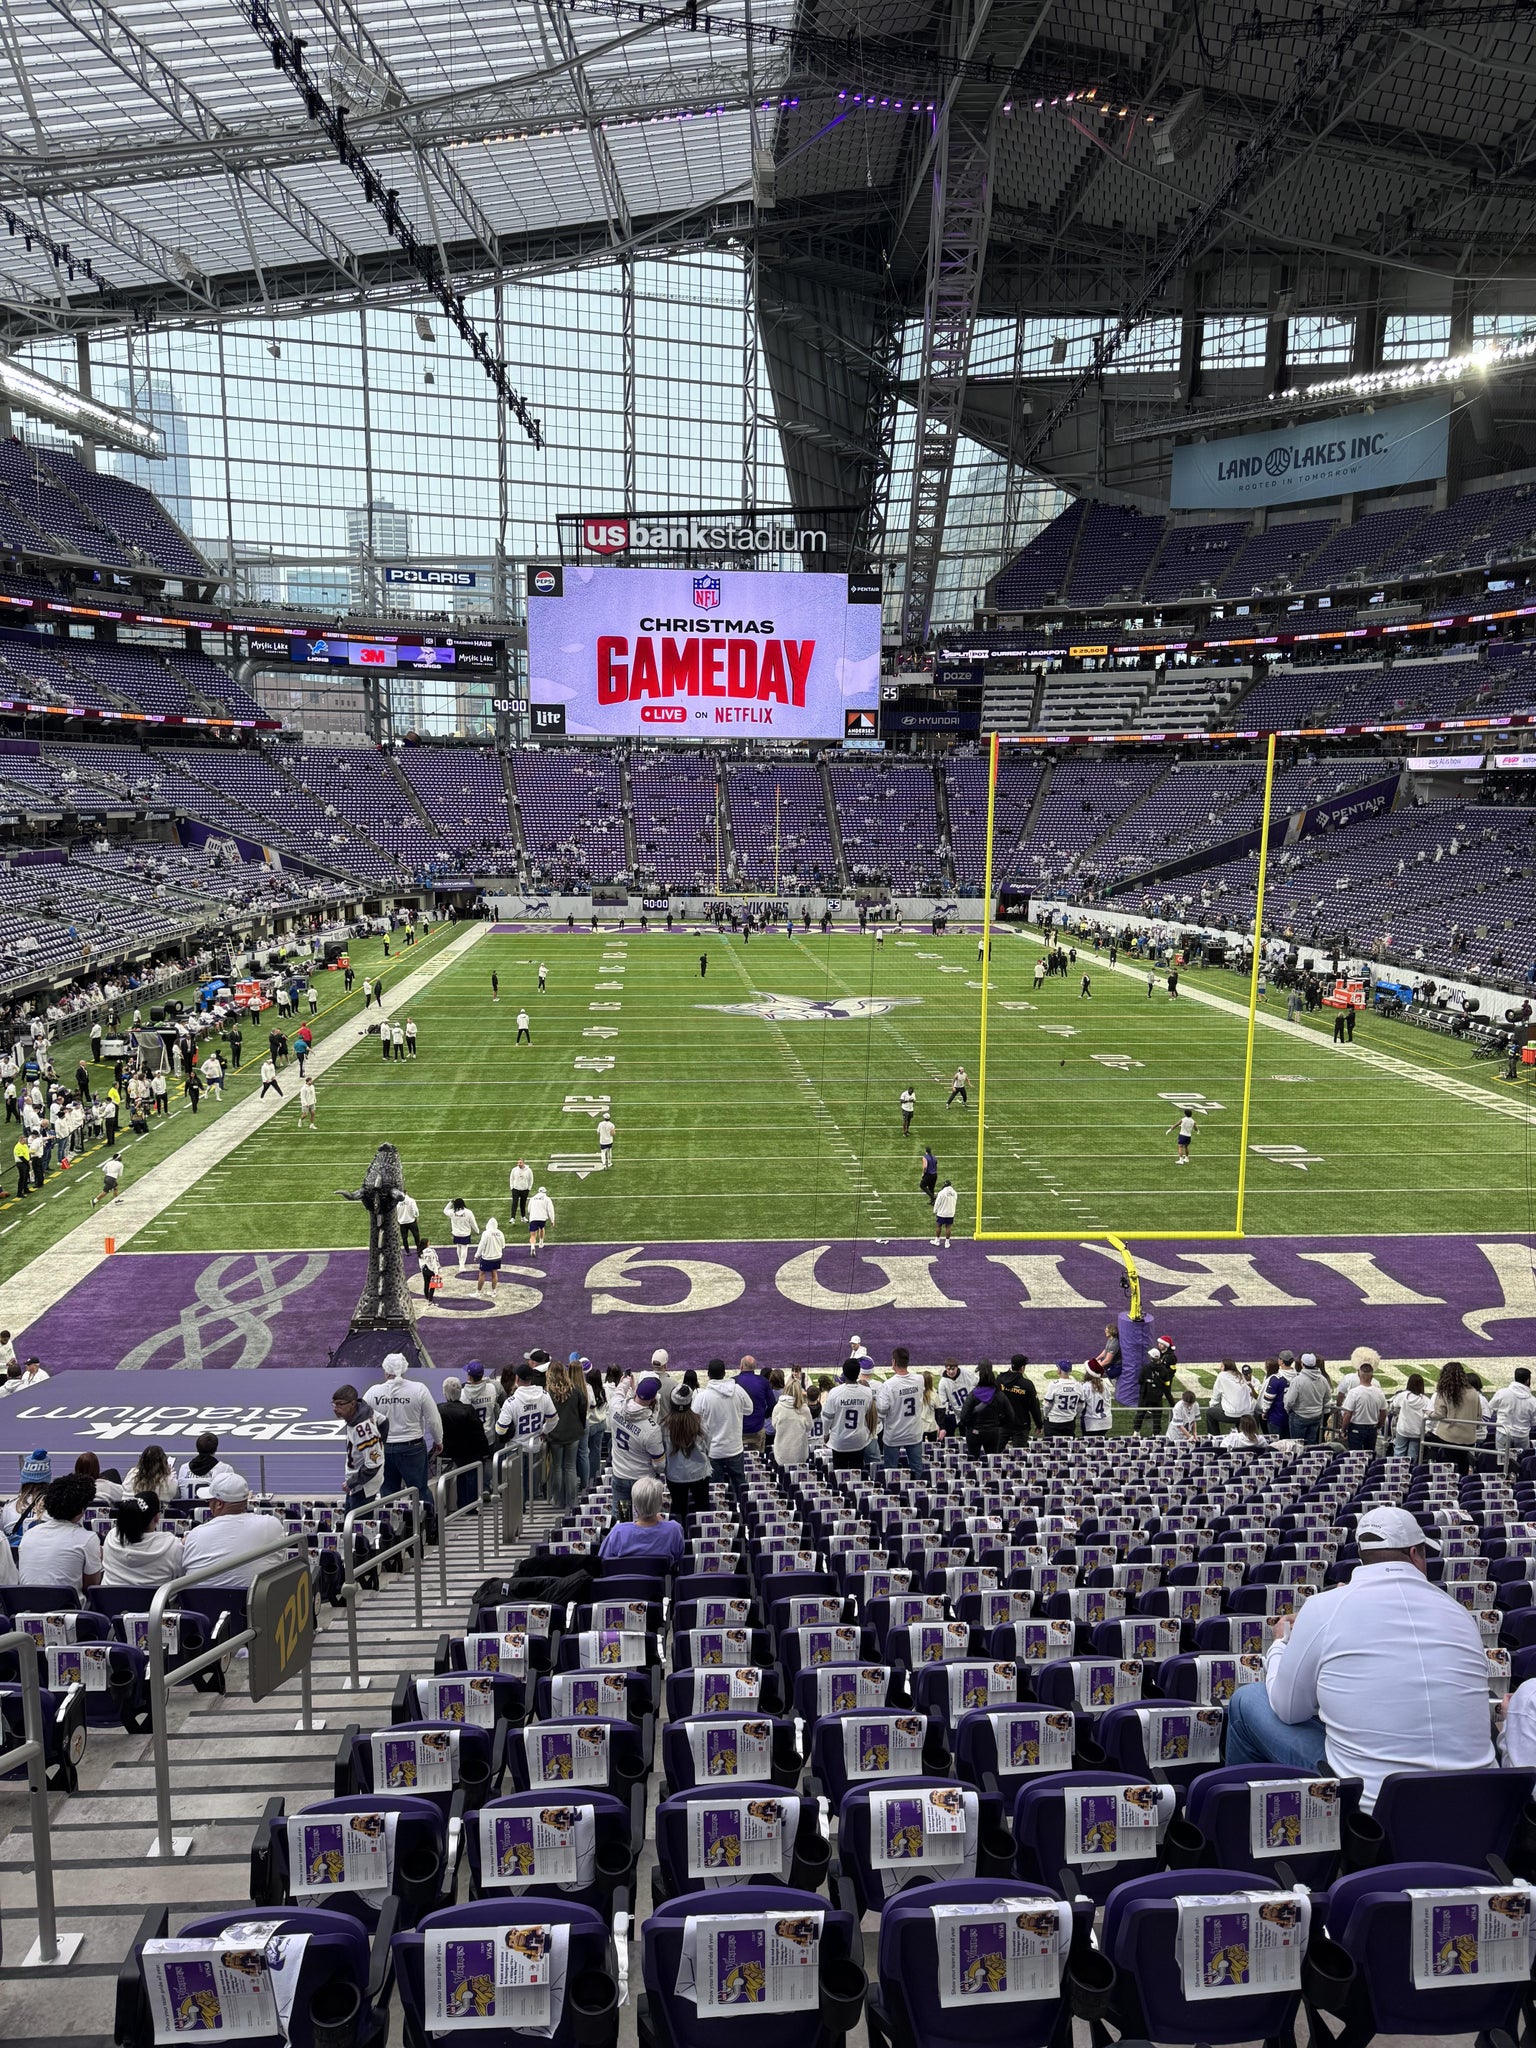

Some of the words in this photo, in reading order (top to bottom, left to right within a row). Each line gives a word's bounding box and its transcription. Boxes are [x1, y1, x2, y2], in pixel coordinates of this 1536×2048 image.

[1218, 456, 1262, 481] LAND
[1239, 480, 1278, 491] ROOTED
[1282, 477, 1293, 485] IN
[391, 569, 471, 585] POLARIS
[535, 578, 556, 586] PEPSI
[694, 590, 719, 608] NFL
[640, 617, 775, 634] CHRISTMAS
[360, 649, 385, 664] 3M
[597, 635, 816, 708] GAMEDAY
[943, 671, 972, 681] paze
[883, 688, 897, 699] 25
[494, 700, 526, 712] 90:00
[535, 711, 561, 726] Lite
[654, 709, 683, 721] LIVE
[695, 711, 708, 719] ON
[715, 707, 773, 724] NETFLIX
[918, 716, 960, 725] HYUNDAI
[1332, 796, 1386, 820] PENTAIR
[643, 899, 669, 909] 90:00
[828, 900, 839, 910] 25
[899, 1387, 920, 1396] ADDISON
[952, 1387, 970, 1407] 18
[523, 1403, 539, 1413] SMITH
[840, 1398, 866, 1407] McCARTHY
[903, 1397, 916, 1417] 3
[1058, 1395, 1078, 1411] 33
[518, 1412, 543, 1435] 22
[844, 1409, 859, 1430] 9
[355, 1423, 373, 1438] 84
[616, 1427, 631, 1451] 5
[275, 1570, 309, 1672] 120
